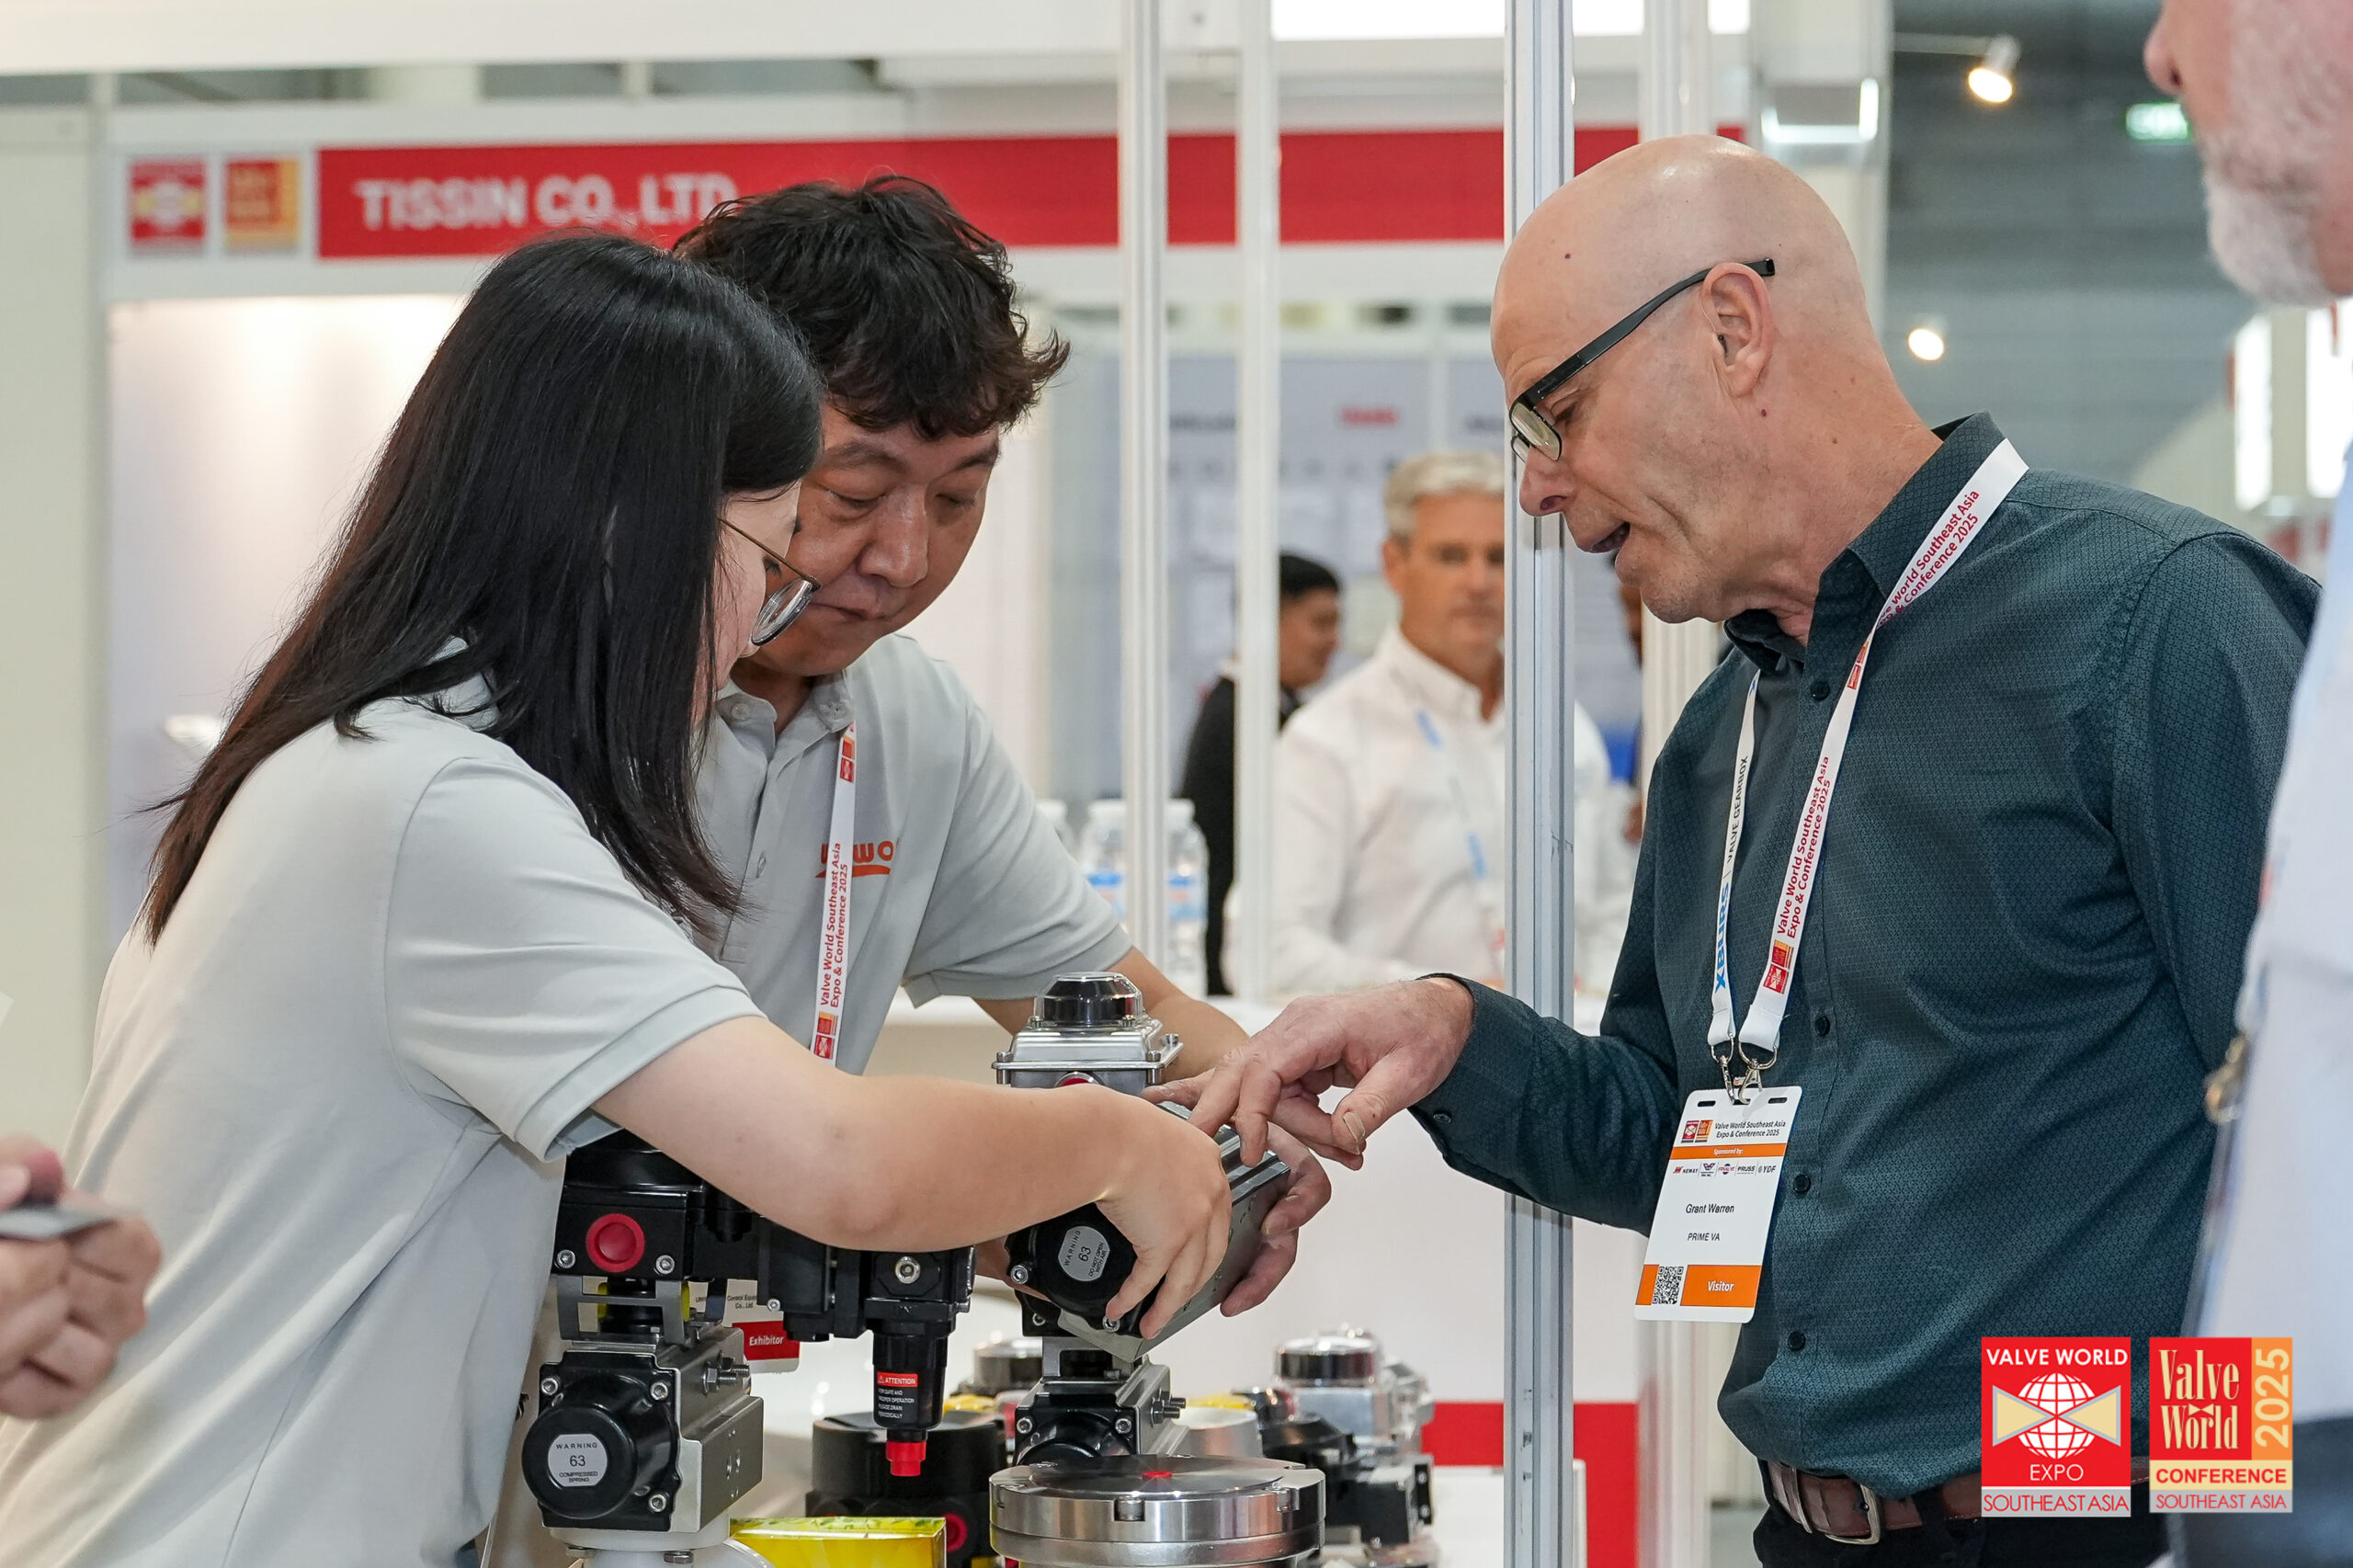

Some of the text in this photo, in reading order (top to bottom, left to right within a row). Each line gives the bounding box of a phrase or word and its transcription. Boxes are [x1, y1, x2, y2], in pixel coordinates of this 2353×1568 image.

[352, 176, 529, 231] TISSIN
[1916, 513, 1962, 570] Southeast
[1957, 490, 1981, 516] Asia
[1904, 542, 1958, 603] Conference
[1952, 513, 1979, 544] 2025
[1733, 756, 1748, 819] GEARBOX
[832, 843, 841, 868] Asia
[1727, 820, 1740, 864] VALVE
[1777, 899, 1792, 935] Valve
[1786, 857, 1803, 897] World
[1797, 787, 1821, 854] Southeast
[1817, 756, 1829, 784] Asia
[1787, 779, 1831, 939] Expo & Conference 2025
[826, 870, 839, 931] Southeast
[824, 934, 835, 971] World
[830, 863, 848, 1007] Expo & Conference 2025
[821, 972, 832, 1006] Valve
[1716, 1131, 1729, 1139] Expo
[1746, 1120, 1775, 1129] Southeast
[1686, 1203, 1734, 1213] Grant Warren
[1064, 1230, 1081, 1267] WARNING
[1078, 1246, 1091, 1262] 63
[1688, 1233, 1721, 1241] PRIME VA
[1707, 1280, 1734, 1291] Visitor
[749, 1335, 784, 1346] Exhibitor
[885, 1377, 916, 1385] ATTENTION
[570, 1455, 585, 1467] 63
